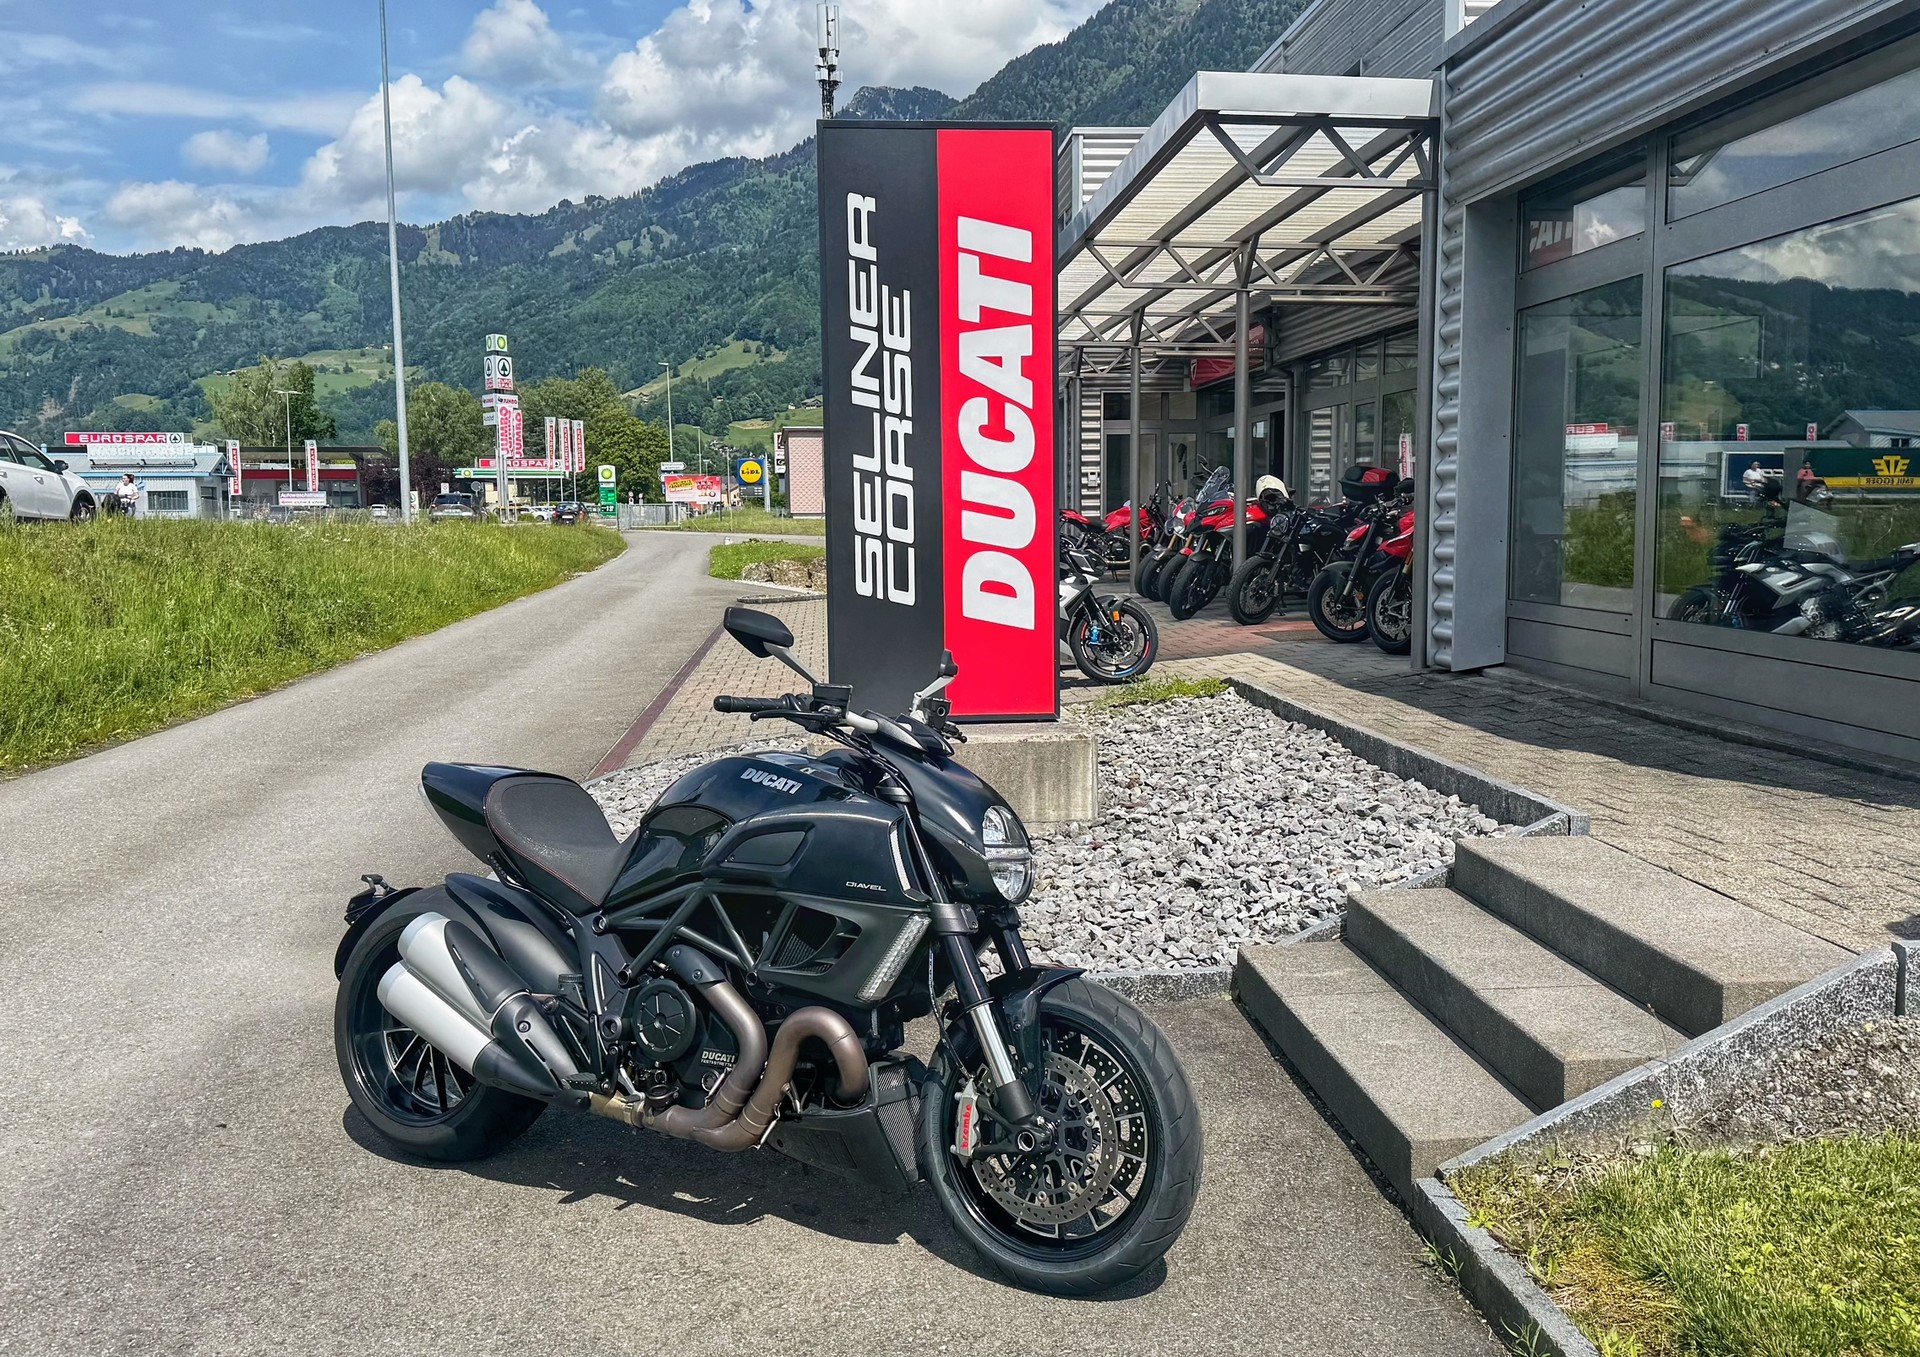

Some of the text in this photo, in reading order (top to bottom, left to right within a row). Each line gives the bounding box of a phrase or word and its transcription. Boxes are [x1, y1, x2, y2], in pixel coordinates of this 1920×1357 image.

[846, 191, 883, 600] SELINER
[79, 434, 167, 443] EUROSPAR
[499, 406, 509, 454] JUMBO
[515, 412, 523, 457] JUMBO
[957, 215, 1037, 631] DUCATI
[881, 284, 917, 608] CORSE
[740, 767, 803, 795] DUCATI
[845, 881, 887, 892] DIAVEL
[701, 1050, 735, 1063] DUCATI
[961, 1104, 972, 1149] brembo
